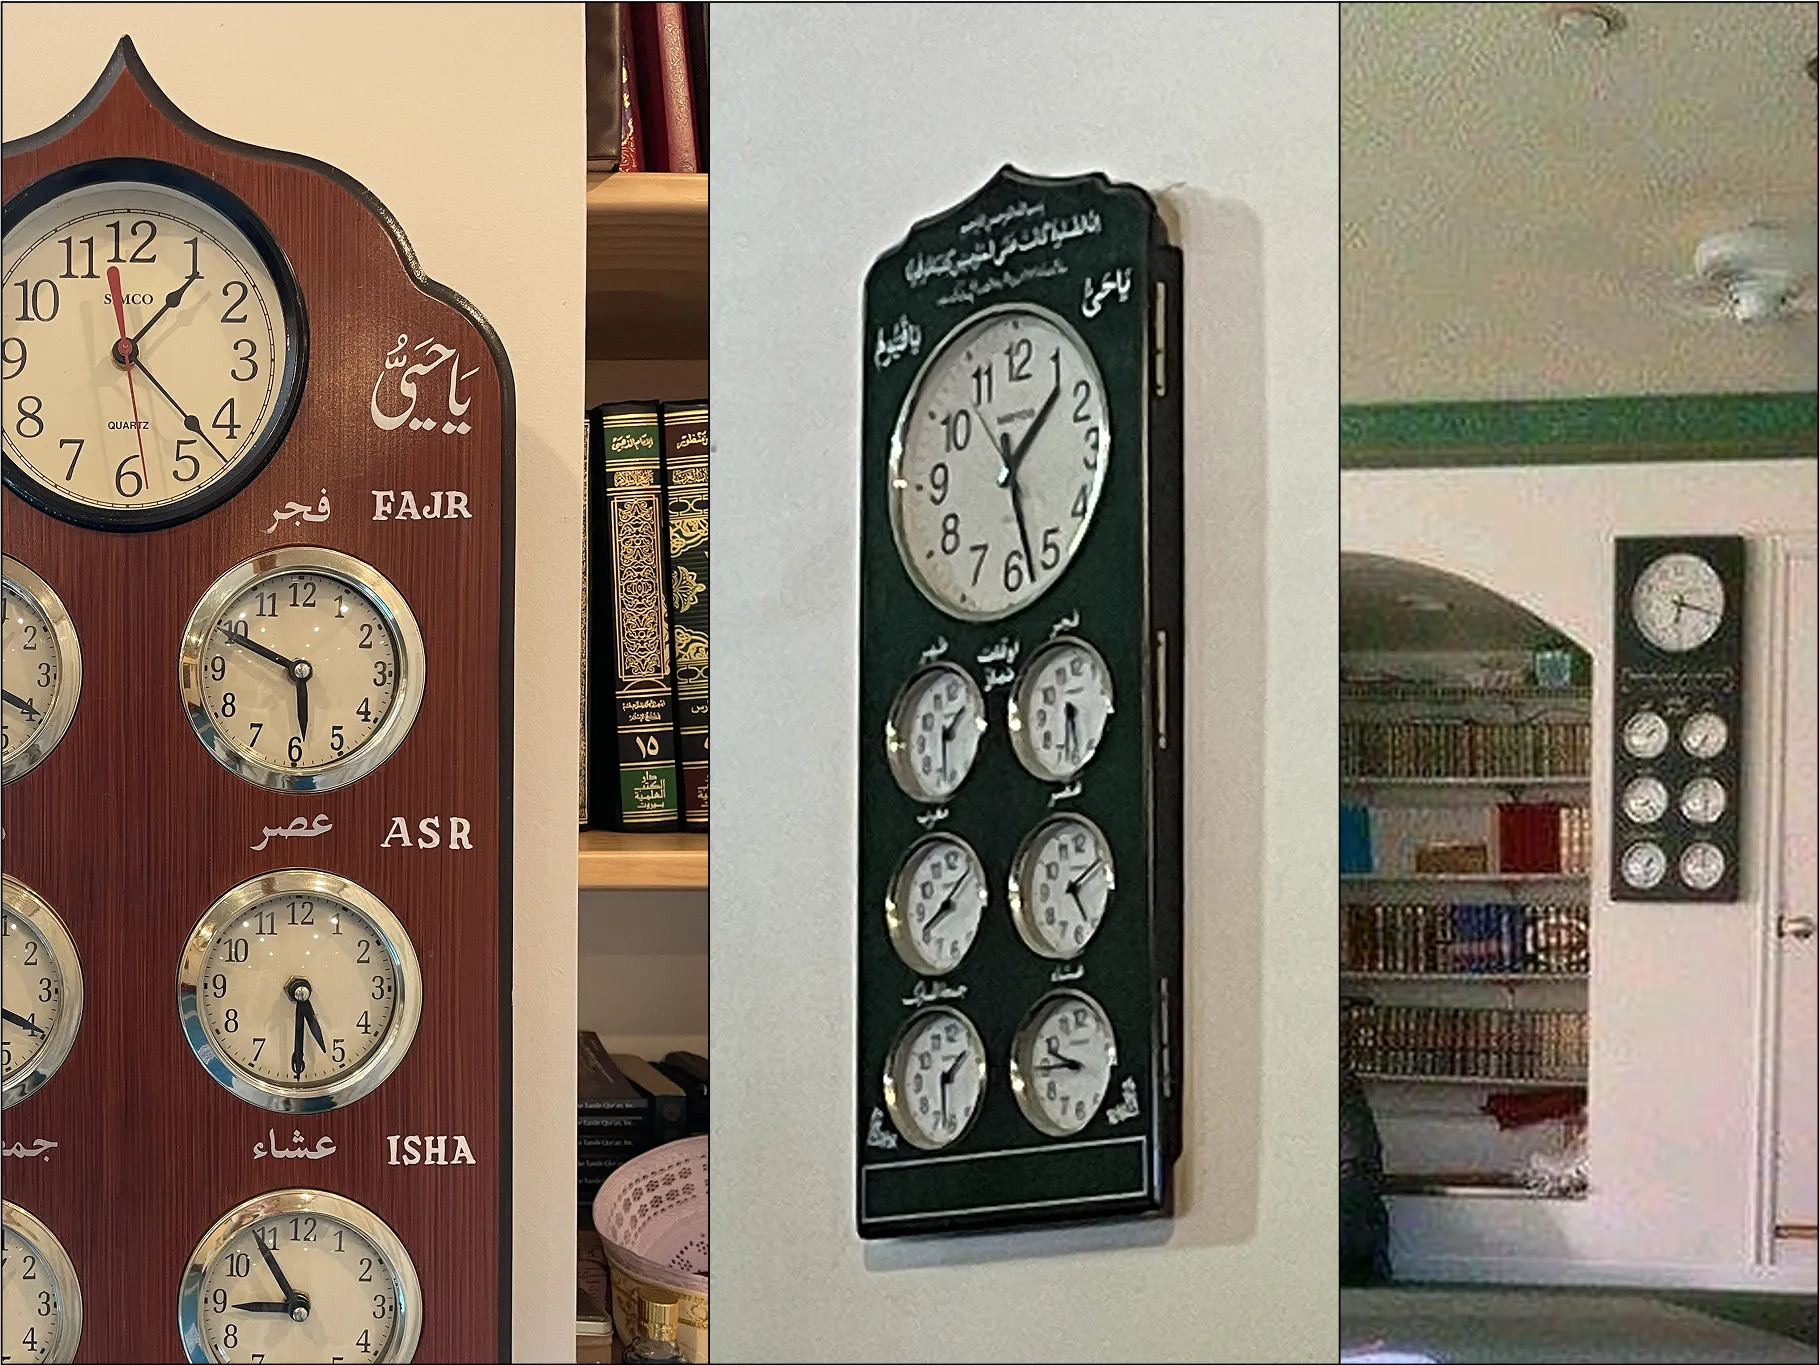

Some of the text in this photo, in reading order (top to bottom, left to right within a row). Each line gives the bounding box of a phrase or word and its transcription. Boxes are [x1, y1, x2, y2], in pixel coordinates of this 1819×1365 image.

[105, 220, 157, 264] 12
[58, 236, 100, 279] 11
[184, 237, 204, 279] 1
[14, 279, 60, 322] 10
[221, 281, 249, 323] 2
[2, 337, 28, 380] 9
[230, 338, 259, 382] 3
[1003, 338, 1033, 382] 12
[1050, 347, 1060, 388] 1
[972, 361, 994, 406] 11
[1073, 380, 1091, 423] 2
[16, 395, 44, 438] 8
[107, 421, 150, 431] QUARTZ
[211, 398, 242, 440] 4
[941, 409, 971, 452] 10
[59, 438, 85, 481] 7
[172, 439, 200, 482] 5
[1084, 427, 1098, 470] 3
[115, 454, 143, 497] 6
[930, 462, 949, 505] 9
[260, 488, 330, 535] فجر
[371, 490, 473, 521] FAJR
[941, 513, 960, 555] 8
[1040, 526, 1060, 570] 5
[970, 544, 988, 586] 7
[1004, 551, 1024, 592] 6
[256, 592, 278, 617] 11
[288, 582, 316, 607] 12
[334, 596, 345, 618] 1
[23, 626, 37, 650] 2
[359, 624, 373, 648] 2
[37, 663, 51, 687] 3
[211, 656, 225, 681] 9
[373, 661, 387, 686] 3
[20, 698, 36, 722] 4
[221, 693, 236, 717] 8
[356, 698, 371, 722] 4
[250, 723, 263, 748] 7
[330, 726, 344, 751] 5
[635, 736, 659, 758] ١٥
[288, 737, 302, 762] 6
[642, 771, 657, 783] دار
[250, 813, 333, 850] عصر
[380, 816, 473, 850] ASR
[254, 911, 278, 935] 11
[287, 902, 315, 926] 12
[332, 913, 343, 935] 1
[24, 942, 38, 966] 2
[224, 938, 249, 963] 10
[356, 939, 370, 963] 2
[39, 978, 51, 1002] 3
[212, 974, 227, 998] 9
[371, 975, 385, 1000] 3
[224, 1009, 239, 1033] 8
[356, 1010, 371, 1034] 4
[252, 1037, 266, 1062] 7
[332, 1039, 346, 1063] 5
[2, 1139, 58, 1162] جم
[253, 1128, 336, 1161] عشاء
[387, 1135, 476, 1166] ISHA
[257, 1226, 279, 1251] 11
[289, 1217, 317, 1242] 12
[334, 1231, 345, 1253] 1
[23, 1256, 36, 1279] 2
[225, 1253, 250, 1278] 10
[359, 1258, 373, 1282] 2
[38, 1291, 51, 1316] 3
[213, 1289, 227, 1313] 9
[373, 1294, 386, 1319] 3
[23, 1327, 38, 1351] 4
[224, 1324, 238, 1348] 8
[356, 1329, 371, 1353] 4
